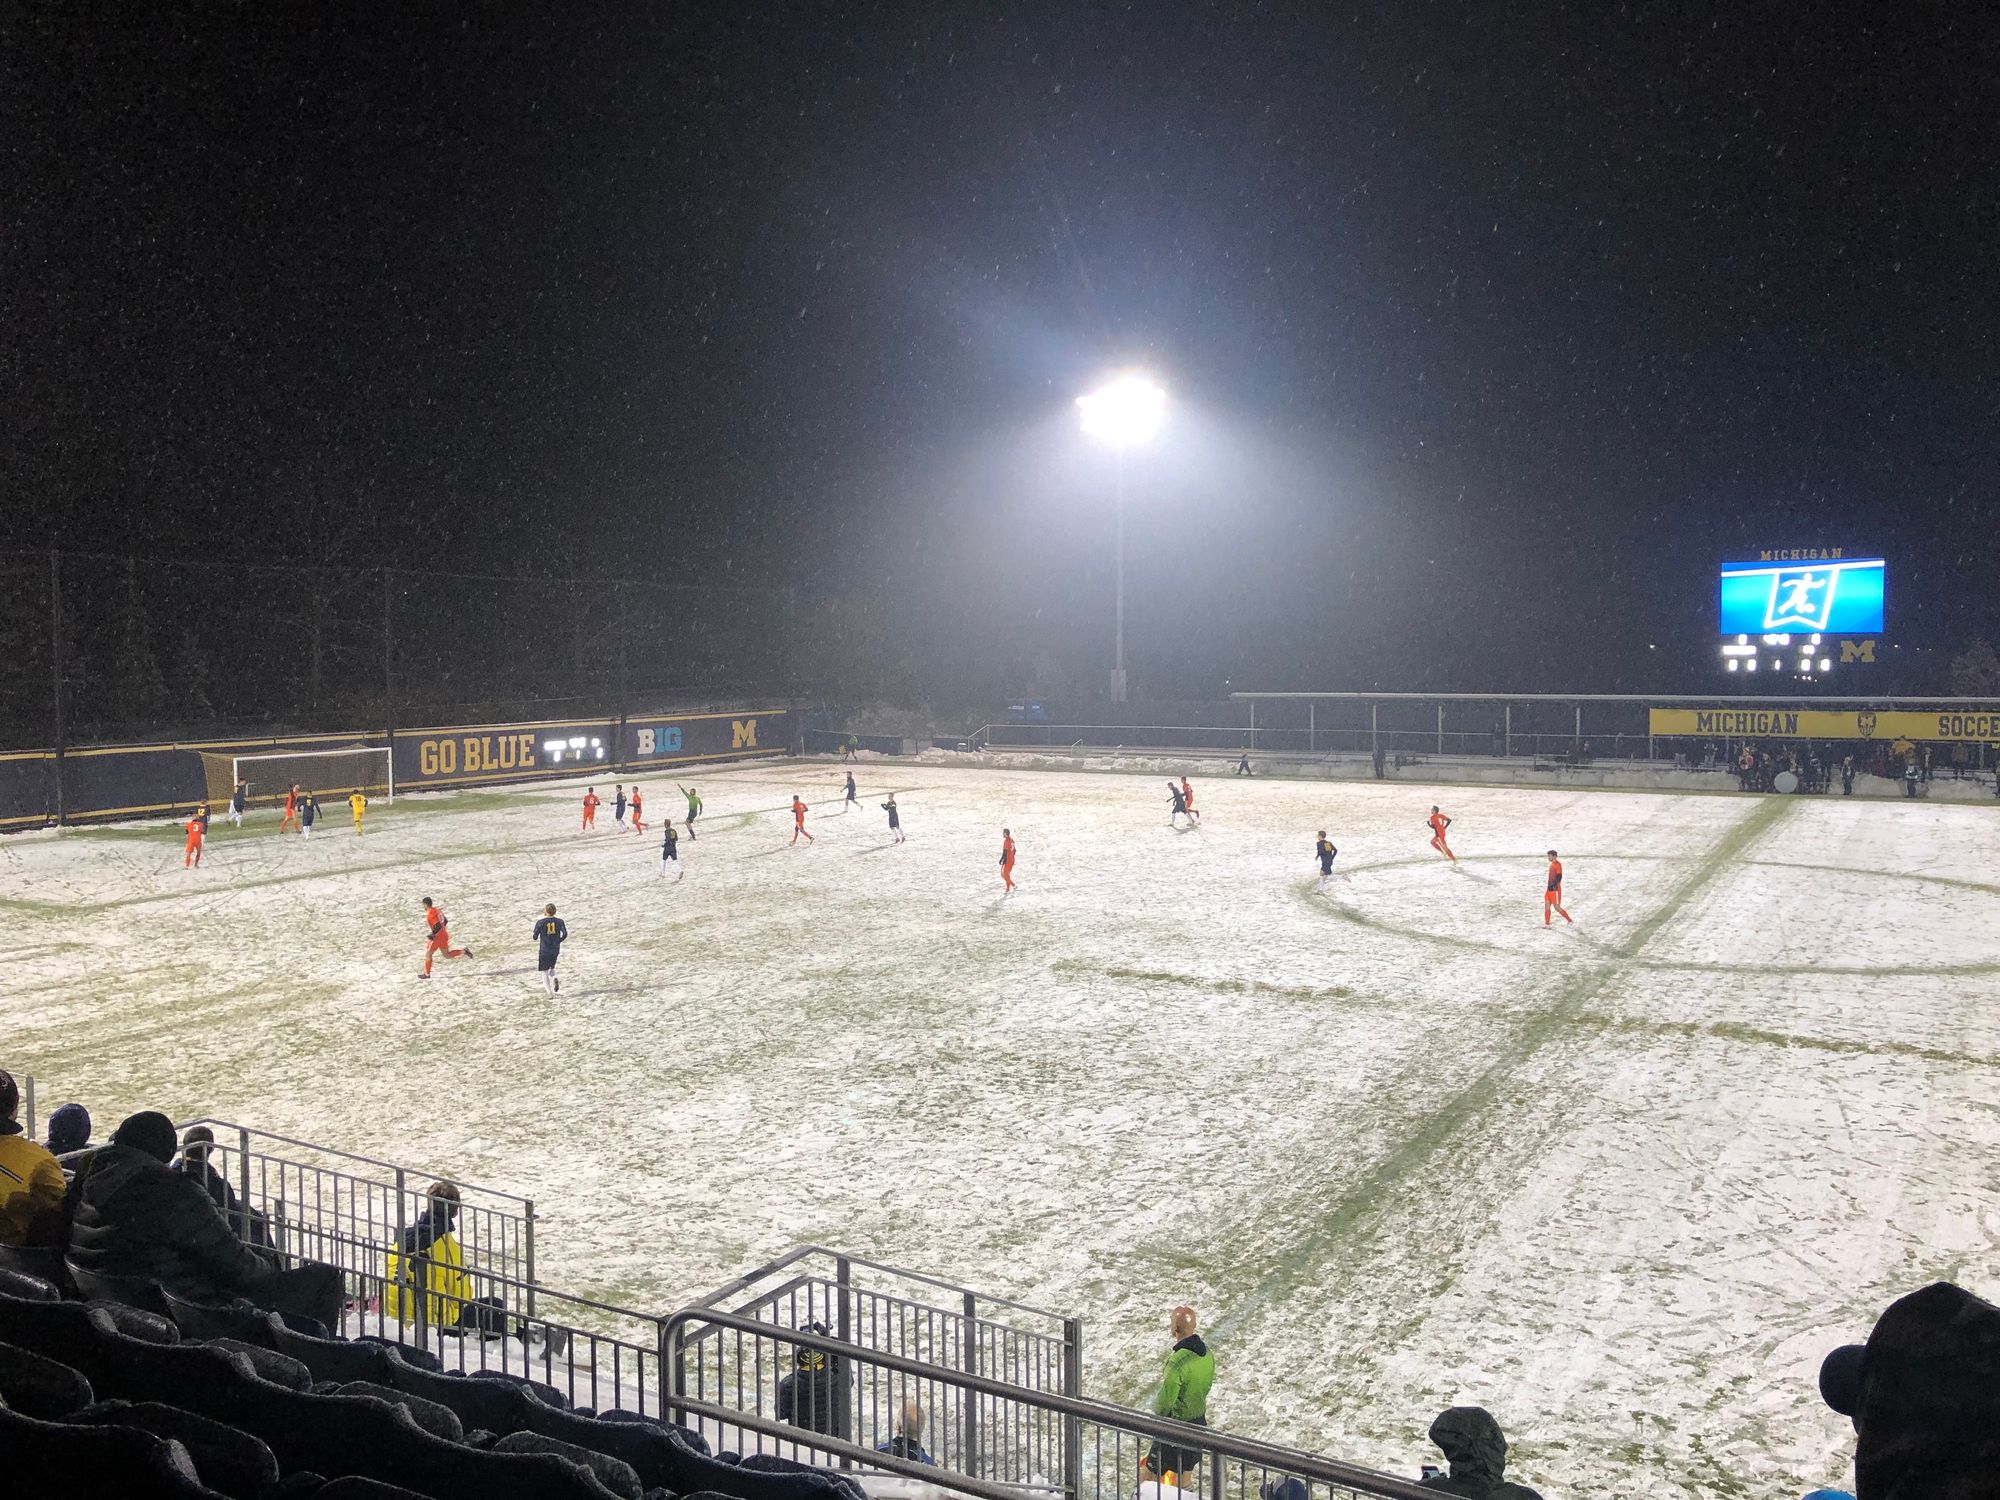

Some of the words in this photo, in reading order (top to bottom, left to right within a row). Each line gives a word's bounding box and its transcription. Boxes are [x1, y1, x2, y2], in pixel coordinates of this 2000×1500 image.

[1760, 548, 1842, 561] MICHIGAN
[1839, 640, 1876, 663] M
[732, 719, 757, 748] M
[1696, 712, 1799, 734] MICHIGAN
[420, 740, 457, 775] GO
[463, 734, 535, 771] BLUE
[193, 824, 199, 832] 3
[547, 922, 556, 935] 11
